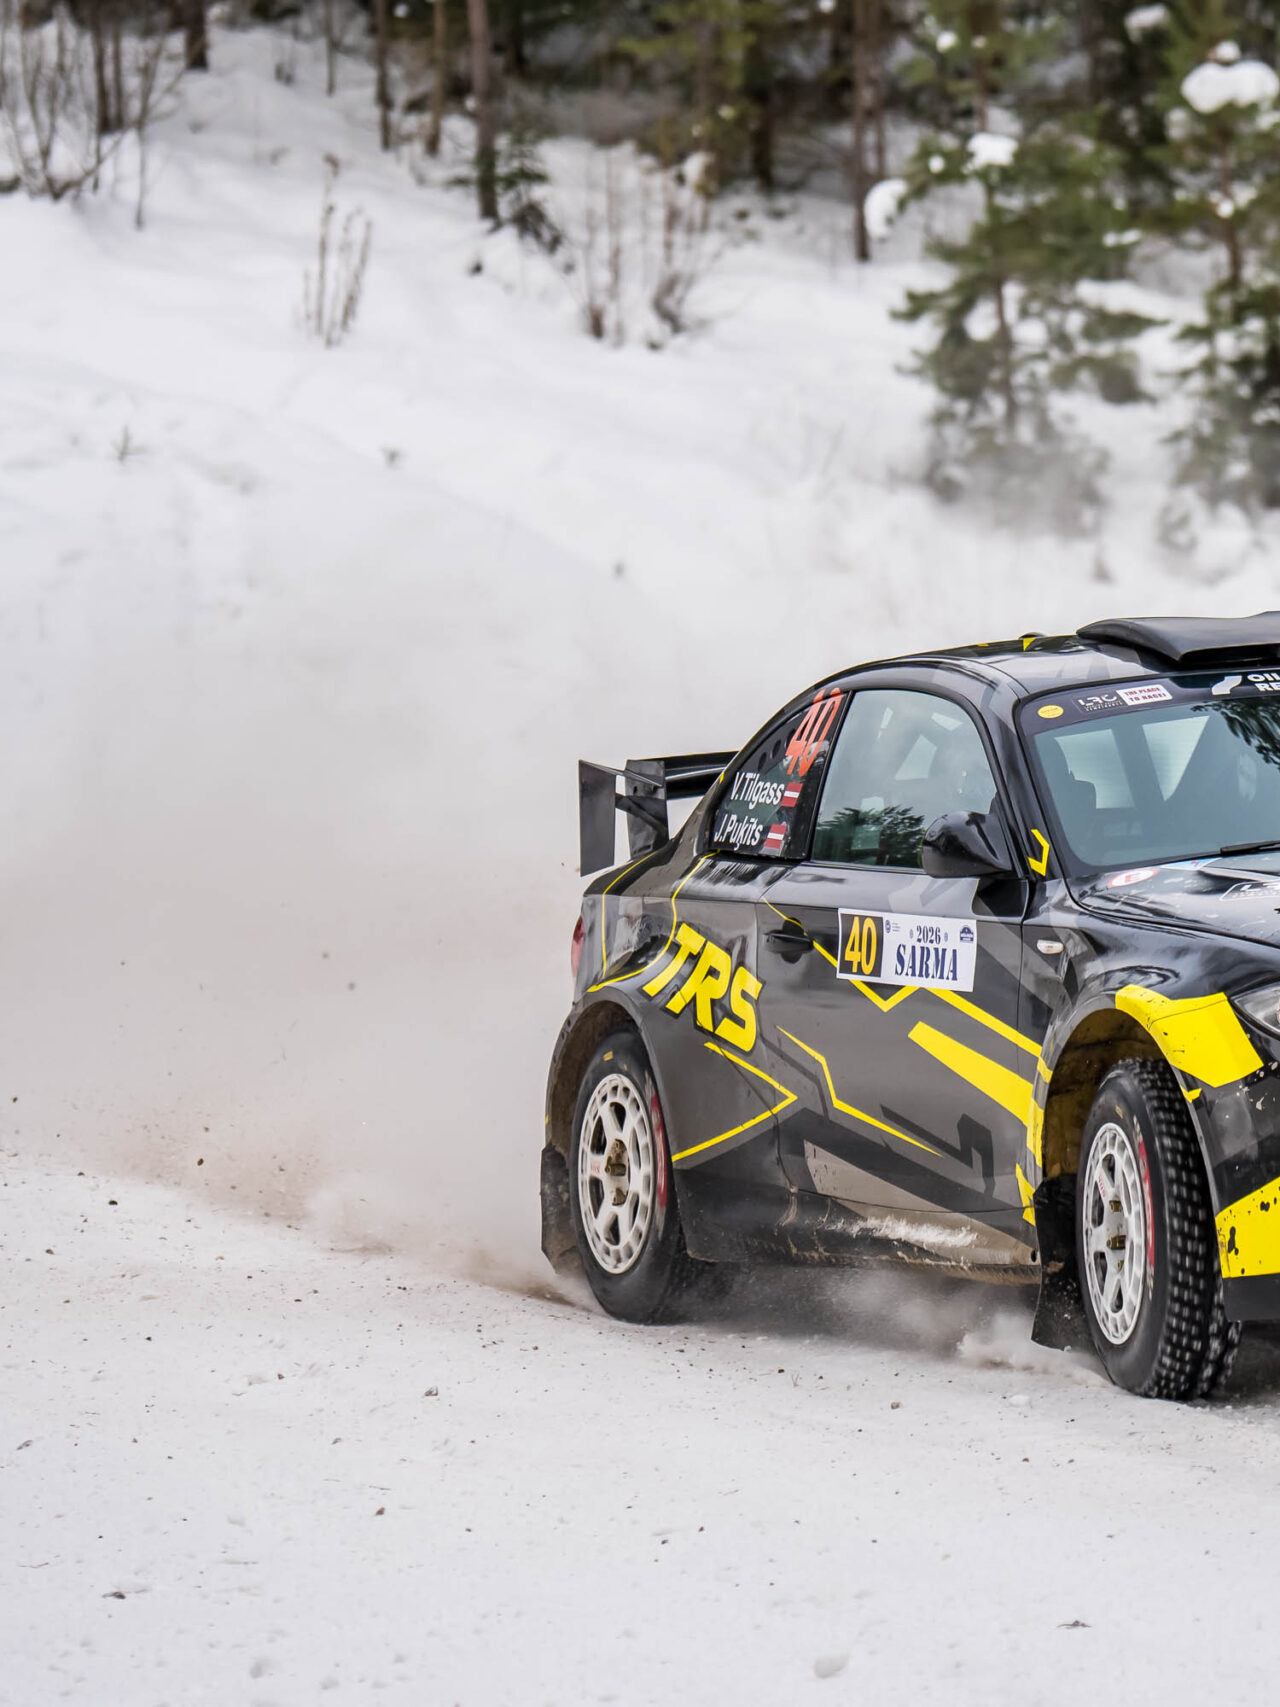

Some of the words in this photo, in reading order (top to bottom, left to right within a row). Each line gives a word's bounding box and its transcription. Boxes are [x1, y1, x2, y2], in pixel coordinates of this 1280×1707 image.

[785, 688, 844, 777] 40
[730, 772, 785, 810] V.Tilgass
[844, 916, 877, 975] 40
[916, 925, 941, 944] 2026
[895, 943, 958, 981] SARMA
[642, 922, 763, 1052] TRS
